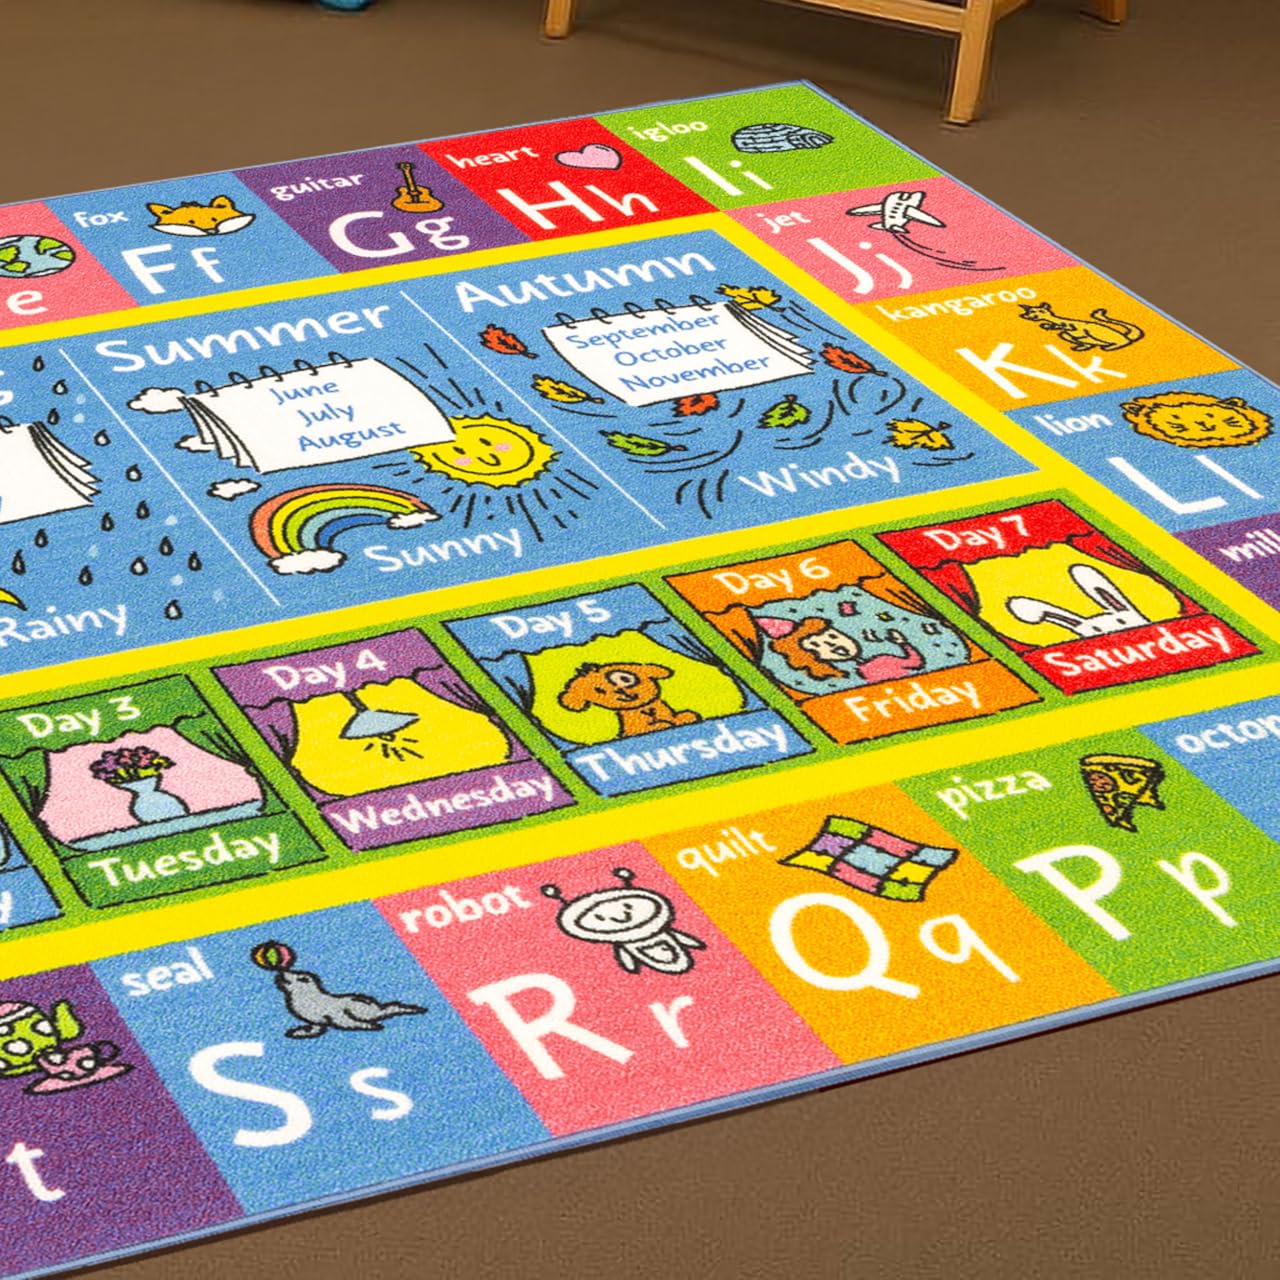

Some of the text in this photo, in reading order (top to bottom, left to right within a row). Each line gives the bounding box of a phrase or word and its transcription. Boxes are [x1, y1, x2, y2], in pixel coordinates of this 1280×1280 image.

[626, 118, 707, 142] igloo
[445, 144, 538, 170] heart
[270, 171, 363, 202] guitar
[75, 208, 128, 228] fox
[758, 209, 810, 235] jet
[454, 250, 716, 313] Autumn
[875, 283, 1035, 323] kangaroo
[95, 302, 391, 372] Summer
[566, 312, 721, 353] September
[612, 336, 728, 366] October
[269, 378, 340, 405] June
[619, 353, 770, 393] November
[299, 402, 355, 428] July
[1033, 401, 1110, 437] lion
[298, 420, 407, 453] August
[737, 453, 901, 498] Windy
[362, 526, 523, 573] Sunny
[923, 516, 1032, 553] Day 7
[713, 557, 832, 596] Day 6
[489, 601, 611, 640] Day 5
[263, 649, 387, 691] Day 4
[1043, 623, 1232, 678] Saturday
[17, 696, 141, 739] Day 3
[843, 679, 979, 722] Friday
[572, 717, 788, 782] Thursday
[327, 772, 555, 834] Wednesday
[935, 768, 1051, 819] pizza
[88, 830, 282, 890] Tuesday
[677, 828, 776, 877] quilt
[398, 882, 531, 933] robot
[121, 947, 214, 997] seal
